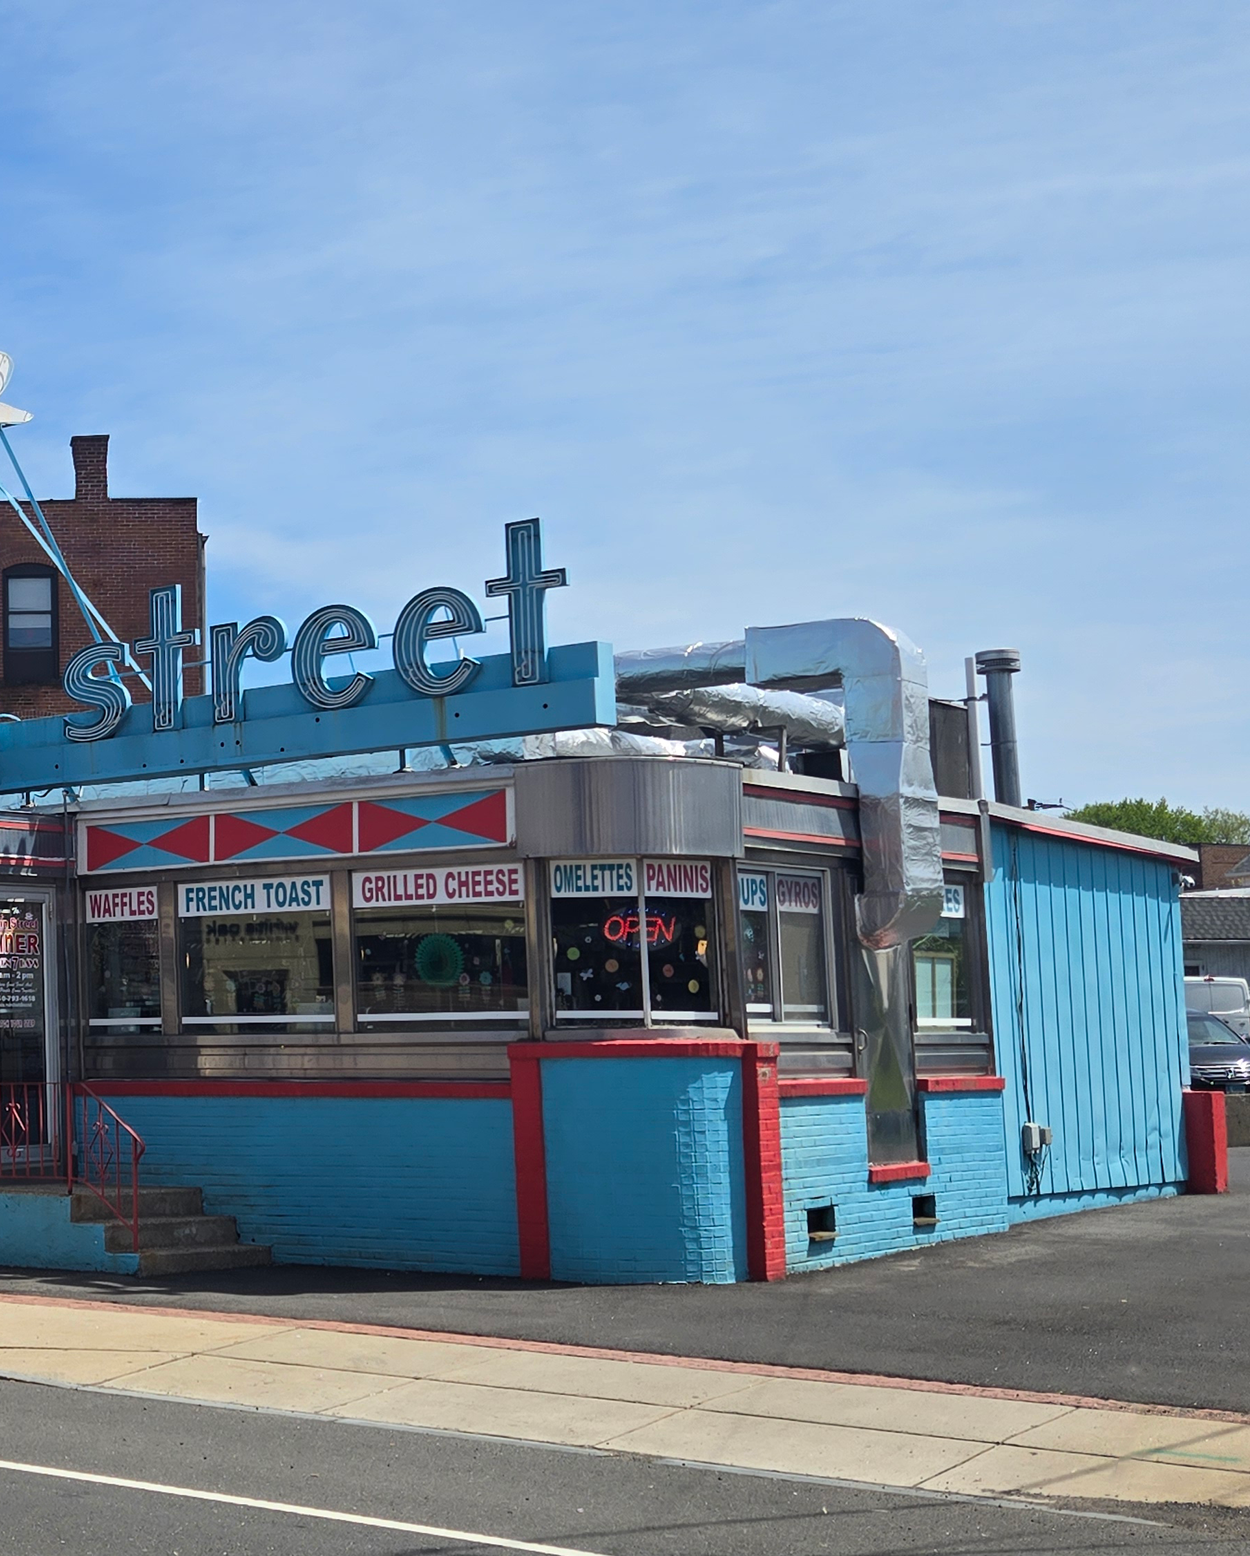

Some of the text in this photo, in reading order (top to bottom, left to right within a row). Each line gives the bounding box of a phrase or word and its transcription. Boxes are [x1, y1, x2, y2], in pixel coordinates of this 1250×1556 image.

[63, 518, 569, 742] street
[361, 868, 519, 903] GRILLED CHEESE
[554, 862, 633, 893] OMELETTES
[646, 863, 710, 893] PANINIS
[738, 877, 767, 907] UPS
[89, 890, 155, 918] WAFFLES
[185, 879, 324, 913] FRENCH TOAST
[777, 878, 819, 909] GYROS
[945, 888, 961, 913] ES
[603, 915, 676, 942] OPEN
[11, 956, 19, 970] 7
